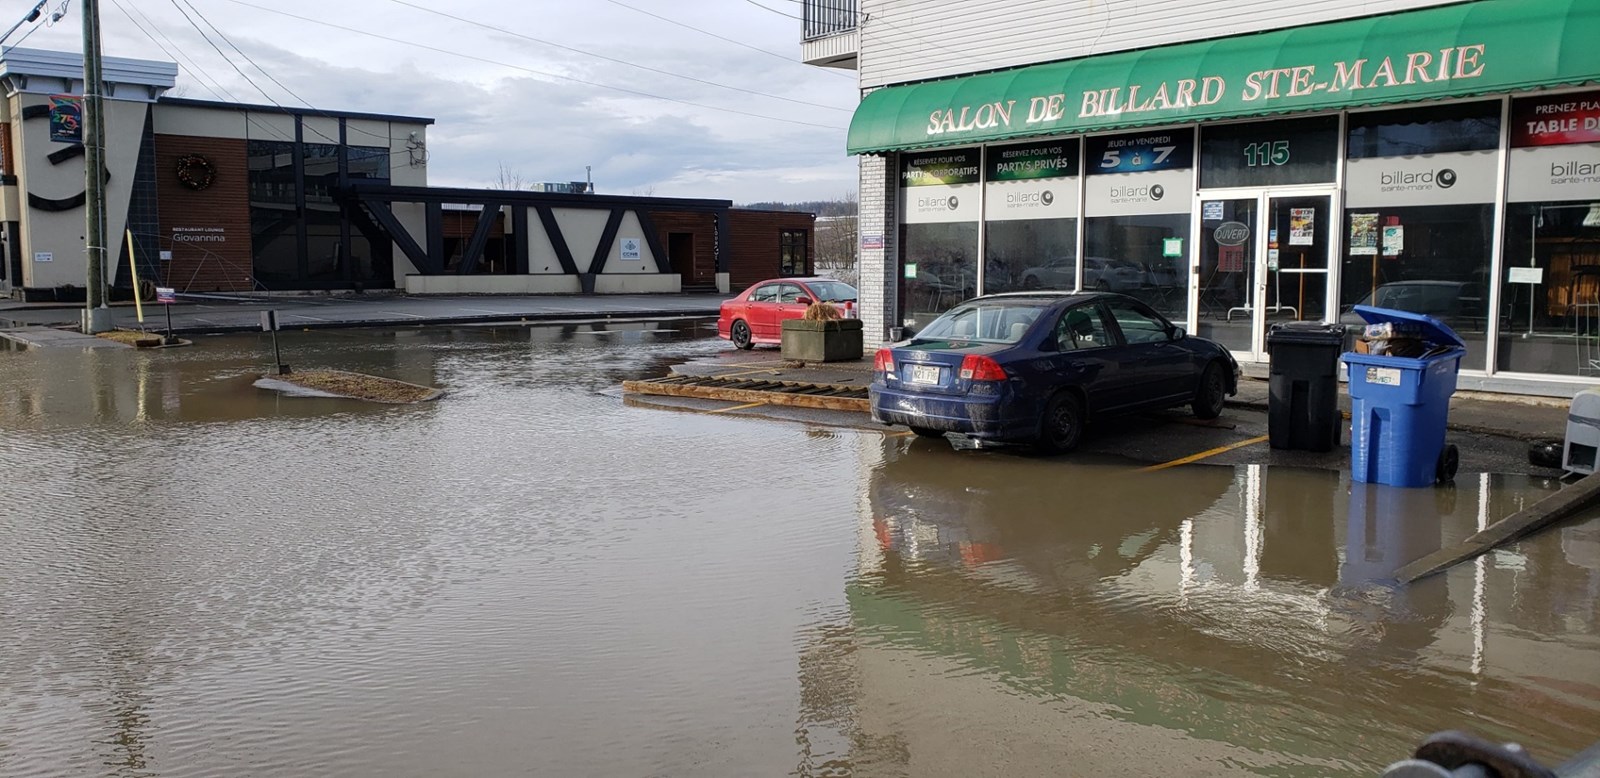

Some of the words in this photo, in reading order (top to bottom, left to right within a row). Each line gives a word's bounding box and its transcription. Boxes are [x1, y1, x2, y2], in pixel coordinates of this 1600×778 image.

[926, 99, 1017, 135] SALON
[1025, 93, 1066, 124] DE
[1078, 75, 1226, 119] BILLARD
[1241, 43, 1486, 101] STE-MARIE
[1535, 102, 1577, 115] PRENEZ
[1526, 118, 1578, 135] TABLE
[1107, 140, 1127, 148] JEUDI
[1136, 136, 1171, 145] VENDREDI
[1002, 149, 1030, 158] RÉSERVEZ
[1030, 148, 1048, 156] POUR
[1048, 146, 1063, 154] VOS
[1100, 150, 1121, 168] 5
[1132, 152, 1142, 165] à
[1152, 145, 1177, 165] 7
[1243, 140, 1290, 167] 115
[996, 161, 1031, 173] PARTYS
[1034, 155, 1068, 170] PRIVÉS
[902, 170, 927, 180] PARTYS
[930, 166, 978, 177] CORPORATIFS
[1381, 169, 1434, 185] billard
[1007, 190, 1040, 203] billard
[1110, 185, 1148, 198] billard
[918, 196, 947, 208] billard
[173, 233, 226, 242] Giovannina
[1215, 228, 1247, 240] OUVERT
